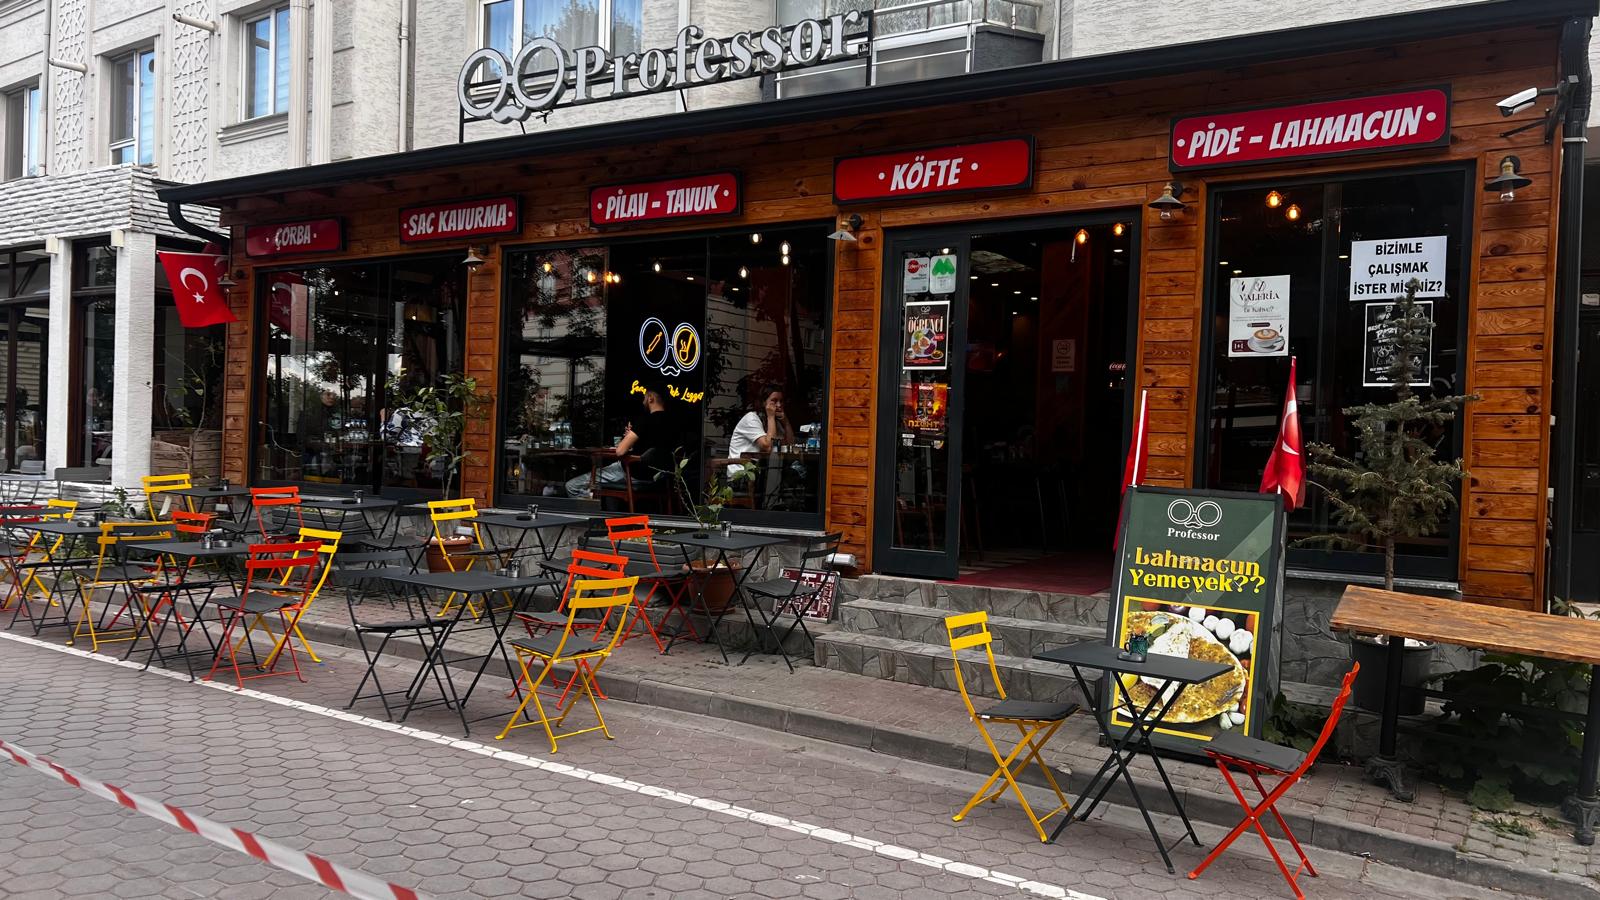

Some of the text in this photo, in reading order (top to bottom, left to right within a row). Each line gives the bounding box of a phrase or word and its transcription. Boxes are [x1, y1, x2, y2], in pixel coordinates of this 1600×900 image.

[573, 9, 865, 104] Professor
[1187, 122, 1245, 159] PİDE
[1269, 105, 1424, 151] LAHMACUN
[890, 155, 964, 191] KÖFTE
[605, 188, 649, 220] PİLAV
[666, 184, 720, 214] TAVUK
[408, 204, 508, 236] SAC KAVURMA
[274, 224, 312, 250] ÇORBA
[1375, 241, 1423, 256] BİZİMLE
[1368, 261, 1429, 277] ÇALIŞMAK
[1239, 290, 1281, 301] VALERİA
[1353, 279, 1443, 295] İSTER MİSNİZ?
[1167, 527, 1221, 541] Professor
[1135, 546, 1260, 577] Lahmacun
[1129, 568, 1266, 593] Yemeyek??
